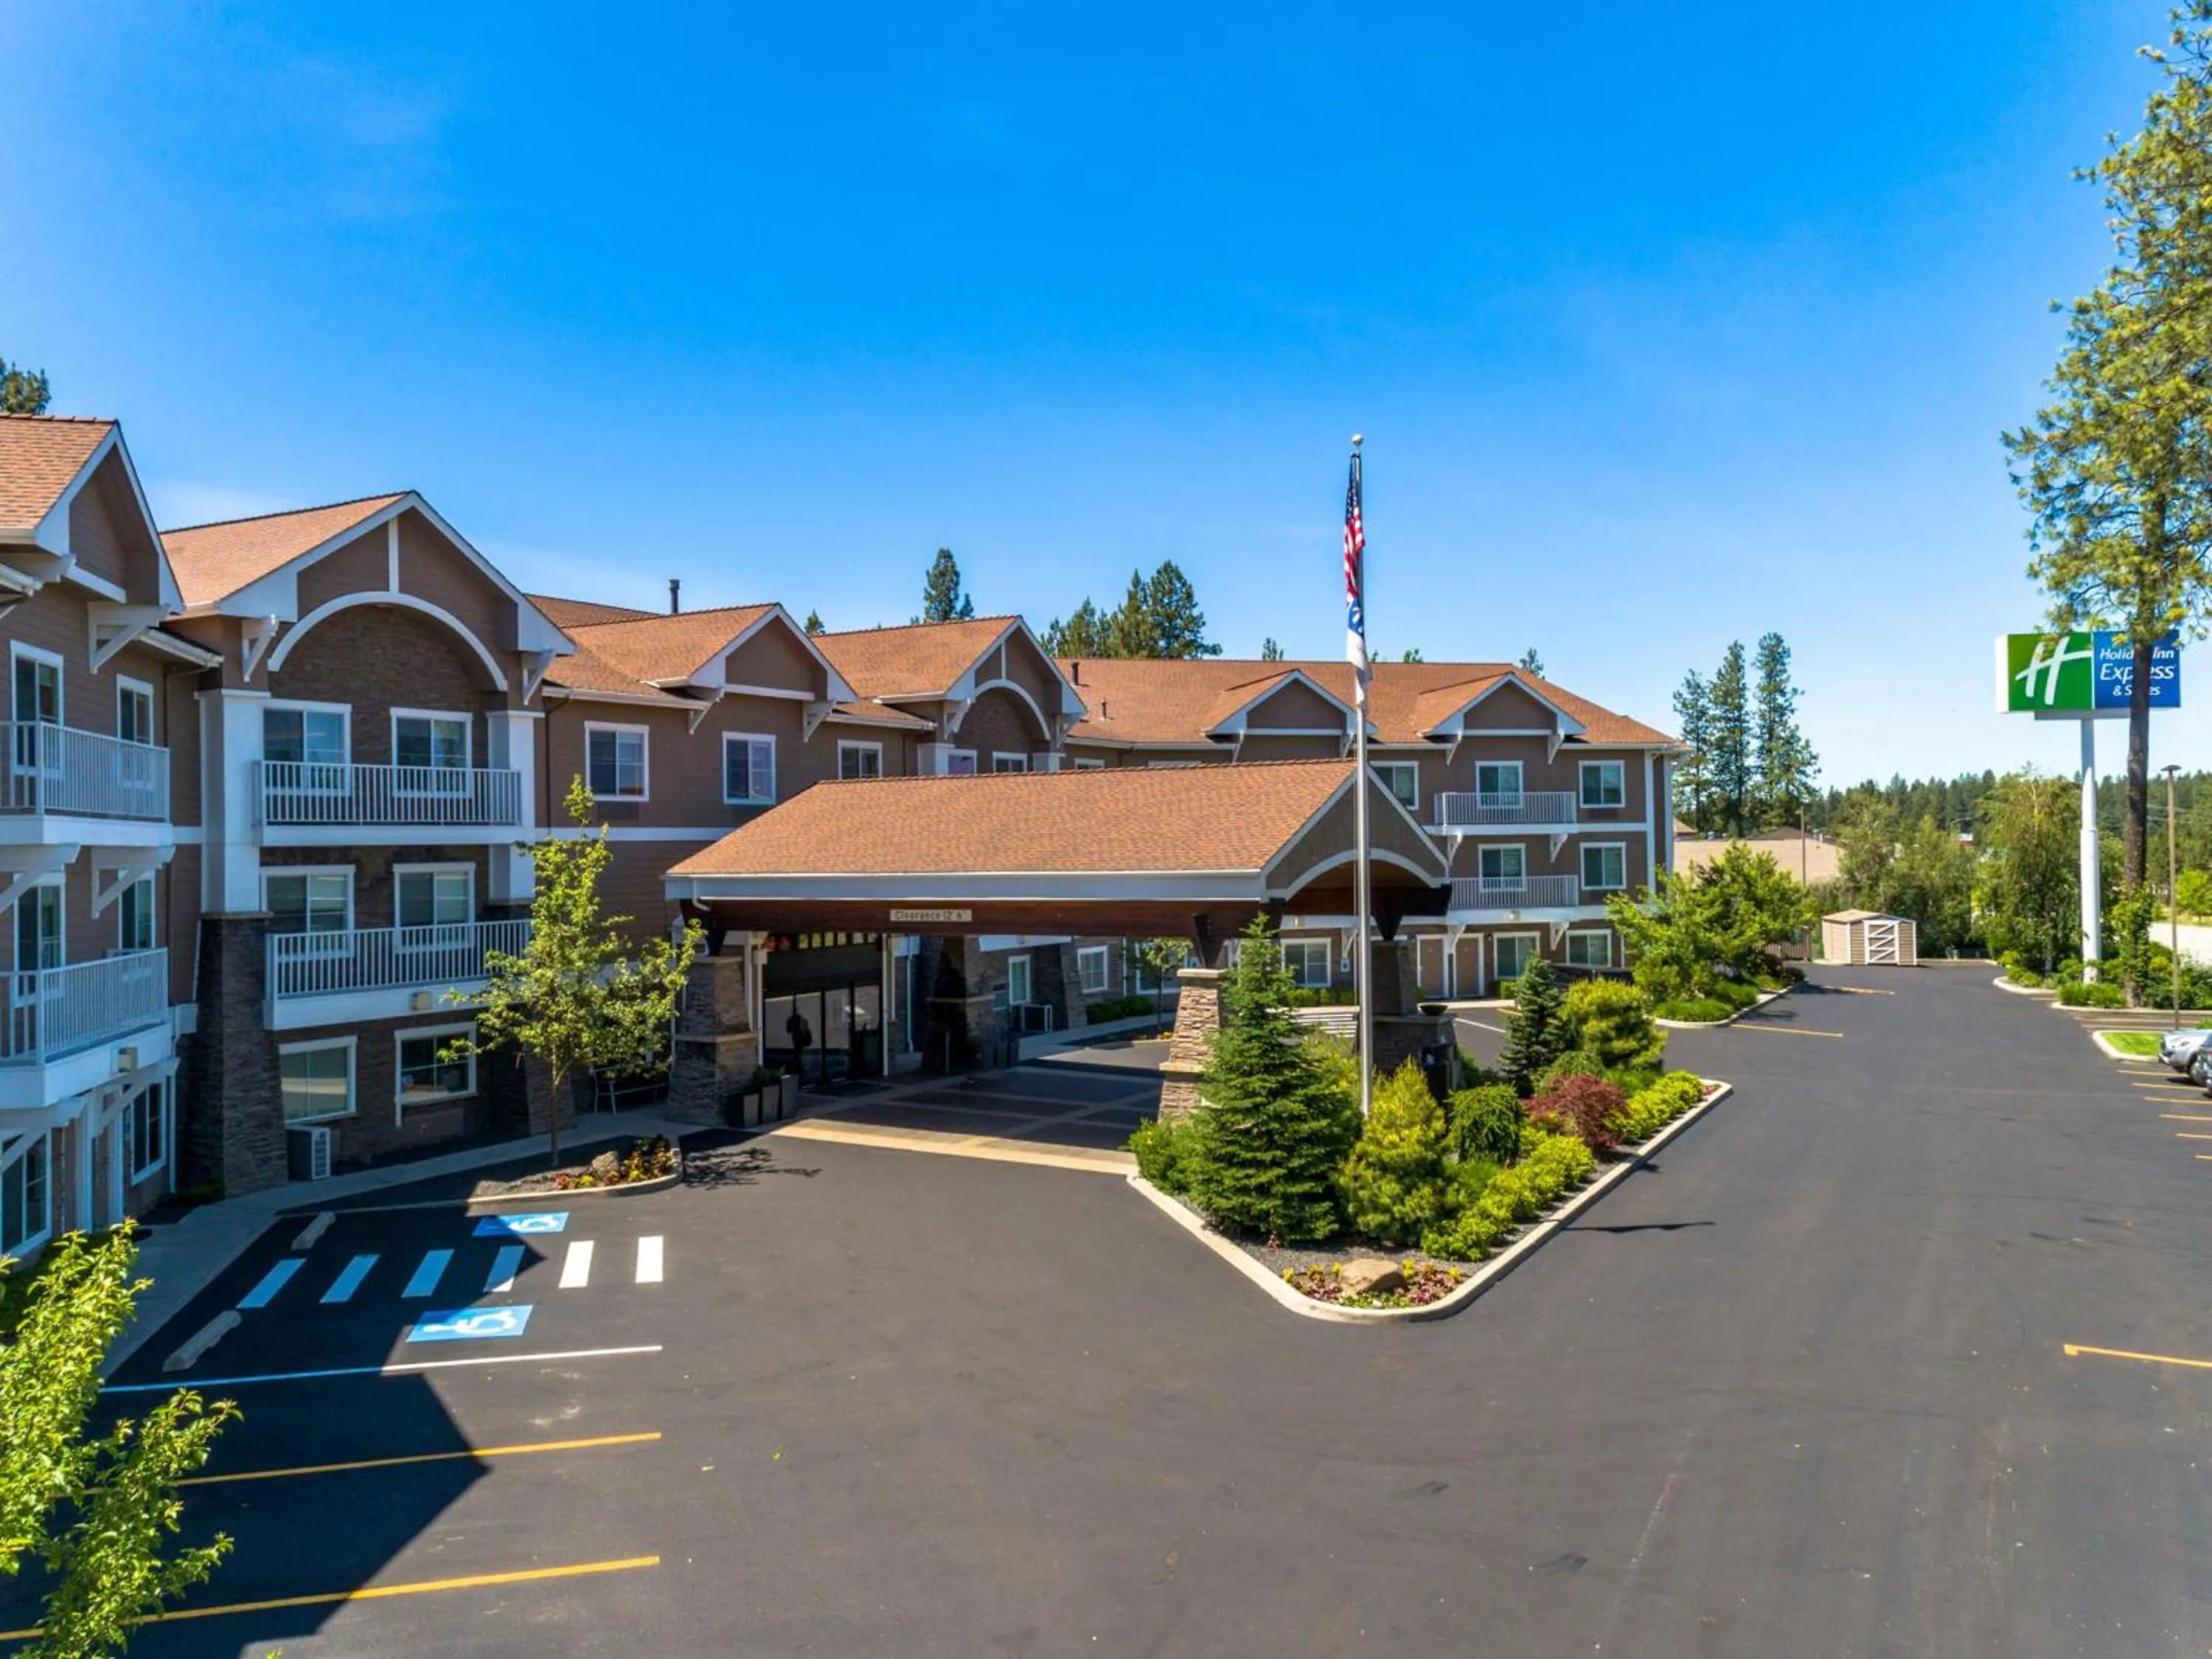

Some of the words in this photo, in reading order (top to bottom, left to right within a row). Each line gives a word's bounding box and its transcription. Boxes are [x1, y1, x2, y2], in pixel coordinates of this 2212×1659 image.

[2099, 647, 2140, 660] Holid
[2152, 647, 2174, 659] Inn
[2100, 663, 2175, 684] Expss
[2112, 685, 2122, 696] &
